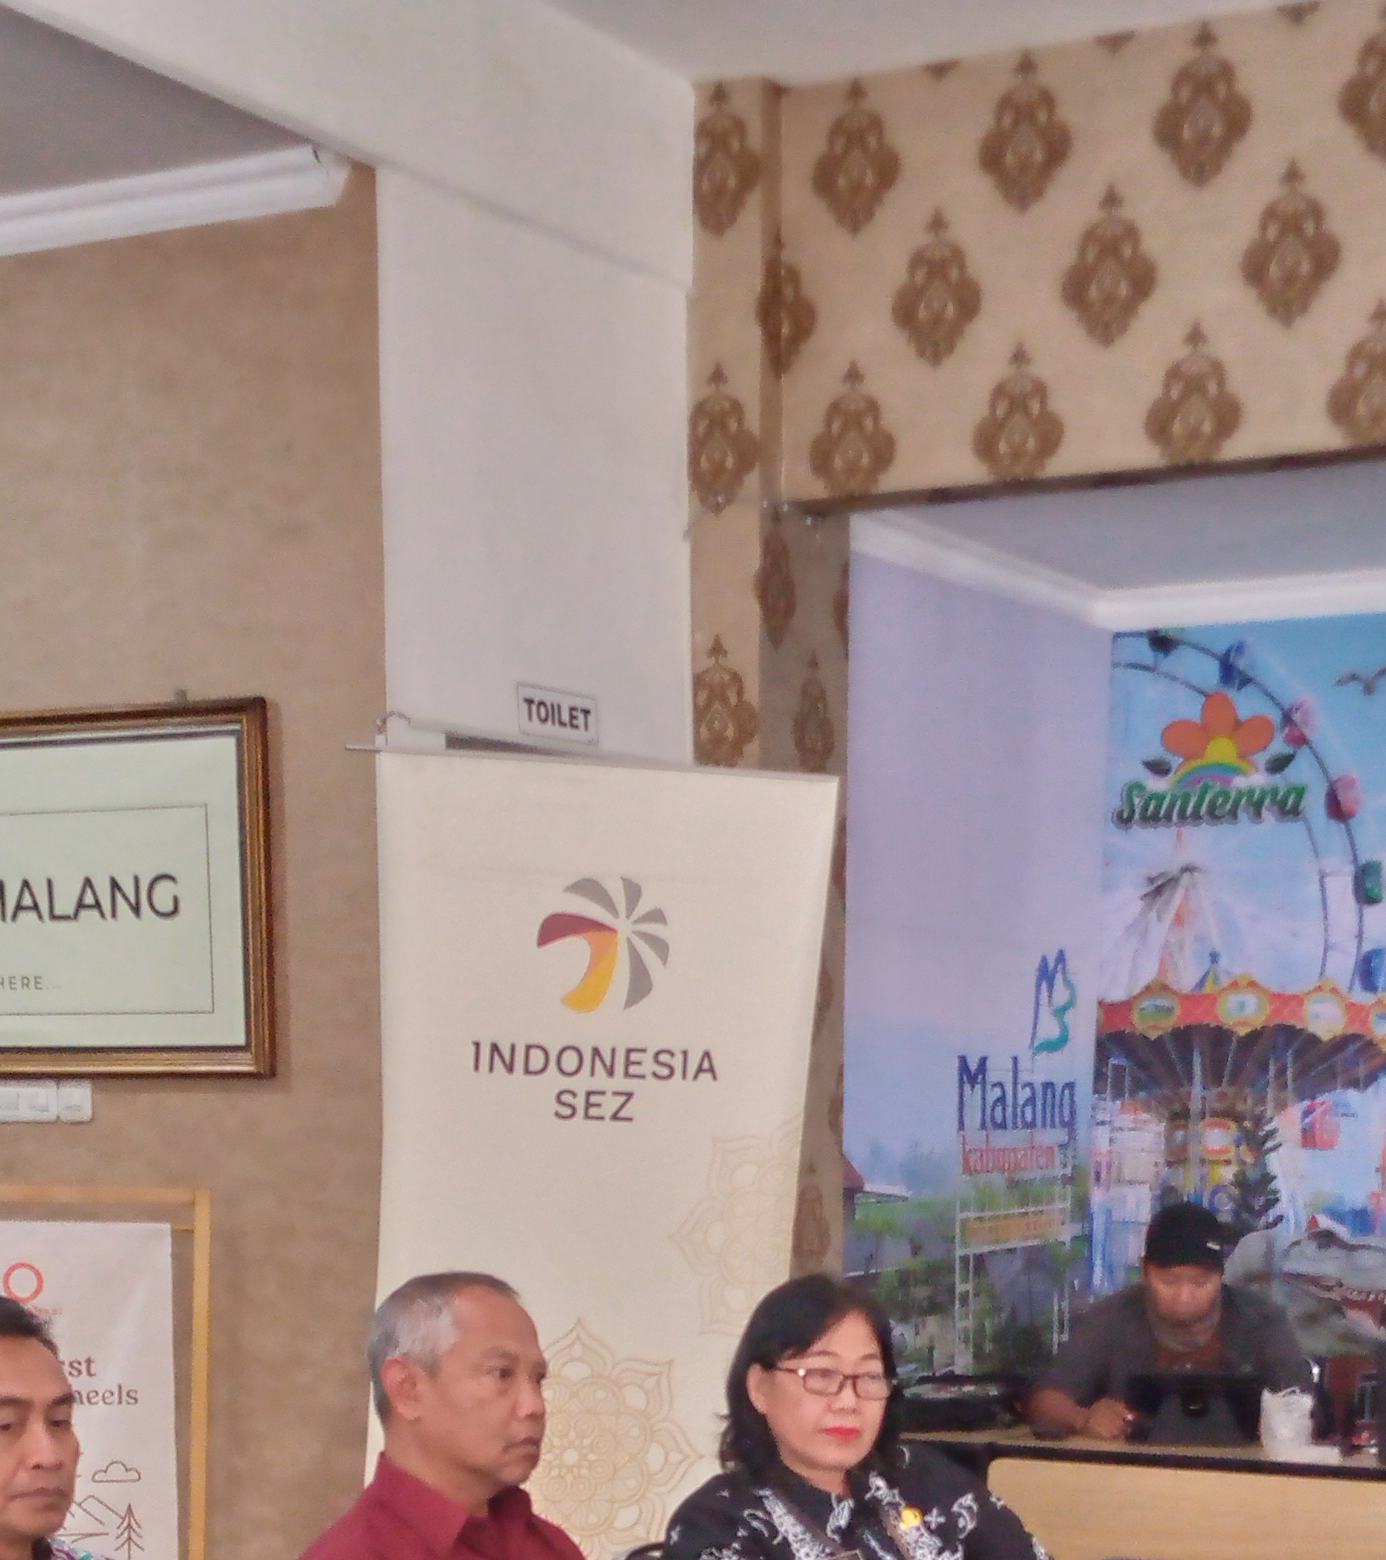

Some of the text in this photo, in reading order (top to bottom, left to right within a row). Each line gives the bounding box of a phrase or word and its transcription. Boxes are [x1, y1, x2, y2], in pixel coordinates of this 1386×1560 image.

[523, 696, 592, 733] TOILET
[1112, 778, 1307, 830] Santerra
[471, 1040, 719, 1083] INDONESIA
[554, 1088, 636, 1123] SEZ
[957, 1055, 1076, 1147] Malang
